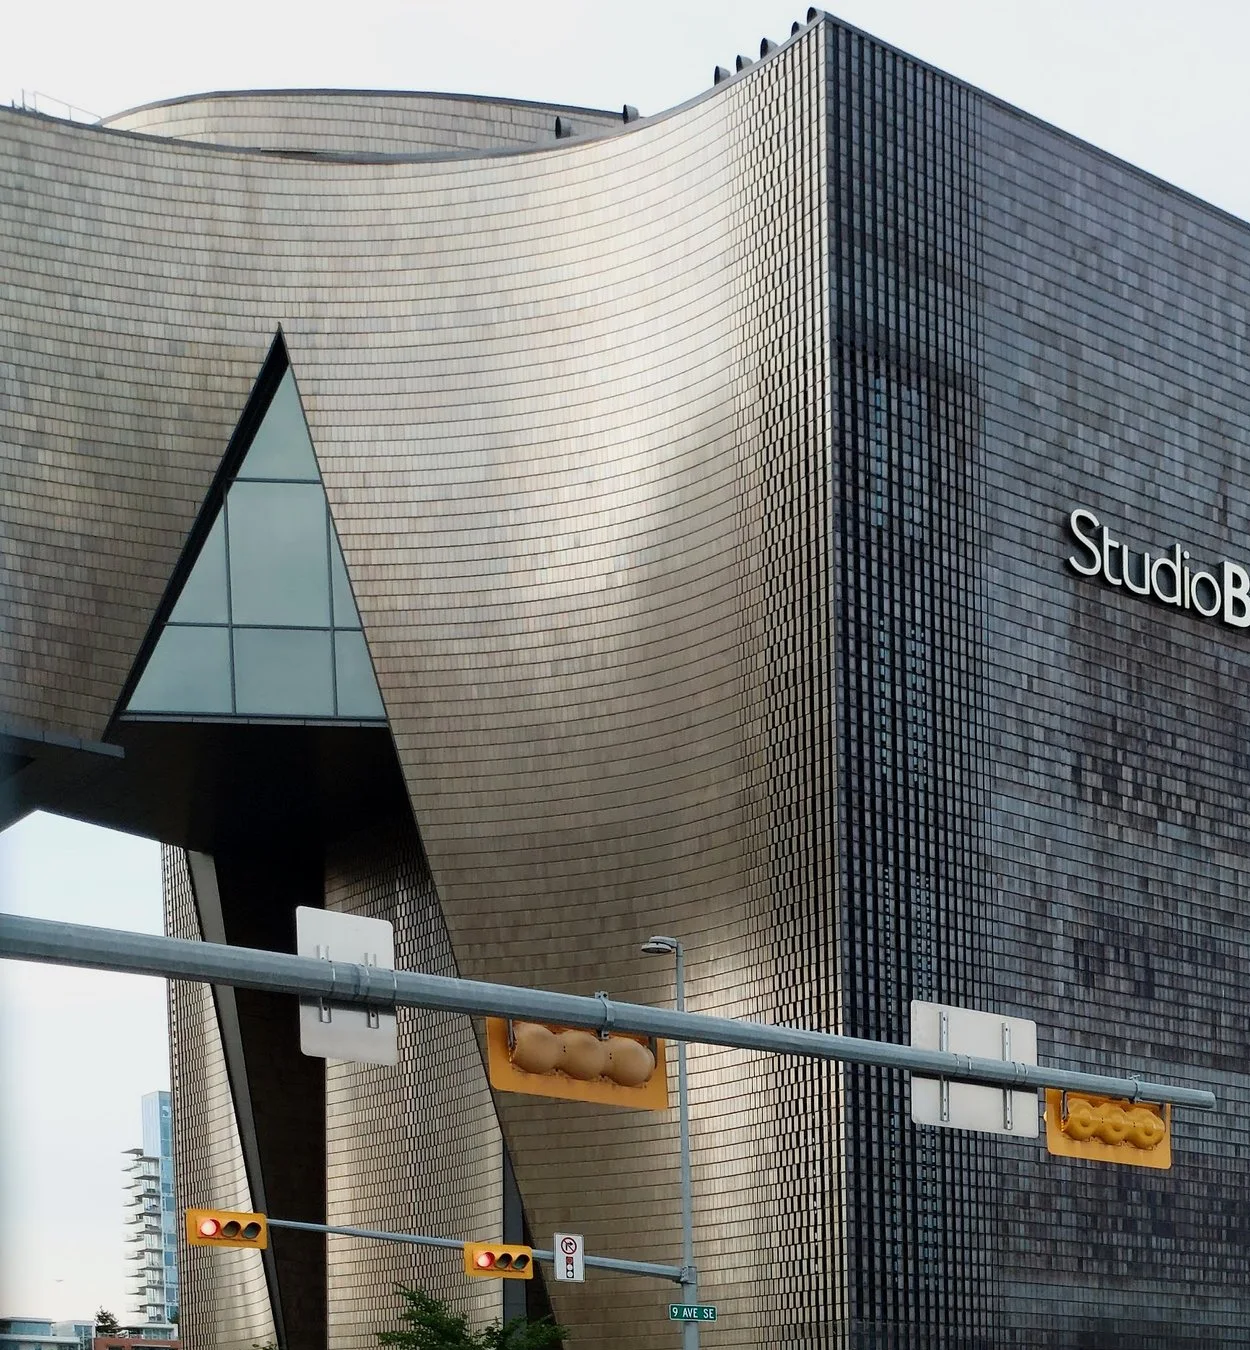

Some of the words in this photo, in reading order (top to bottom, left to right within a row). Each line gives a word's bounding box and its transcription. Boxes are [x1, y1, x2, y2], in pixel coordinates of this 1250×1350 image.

[672, 1306, 679, 1317] 9
[682, 1307, 699, 1318] AVE
[703, 1308, 715, 1319] SE
